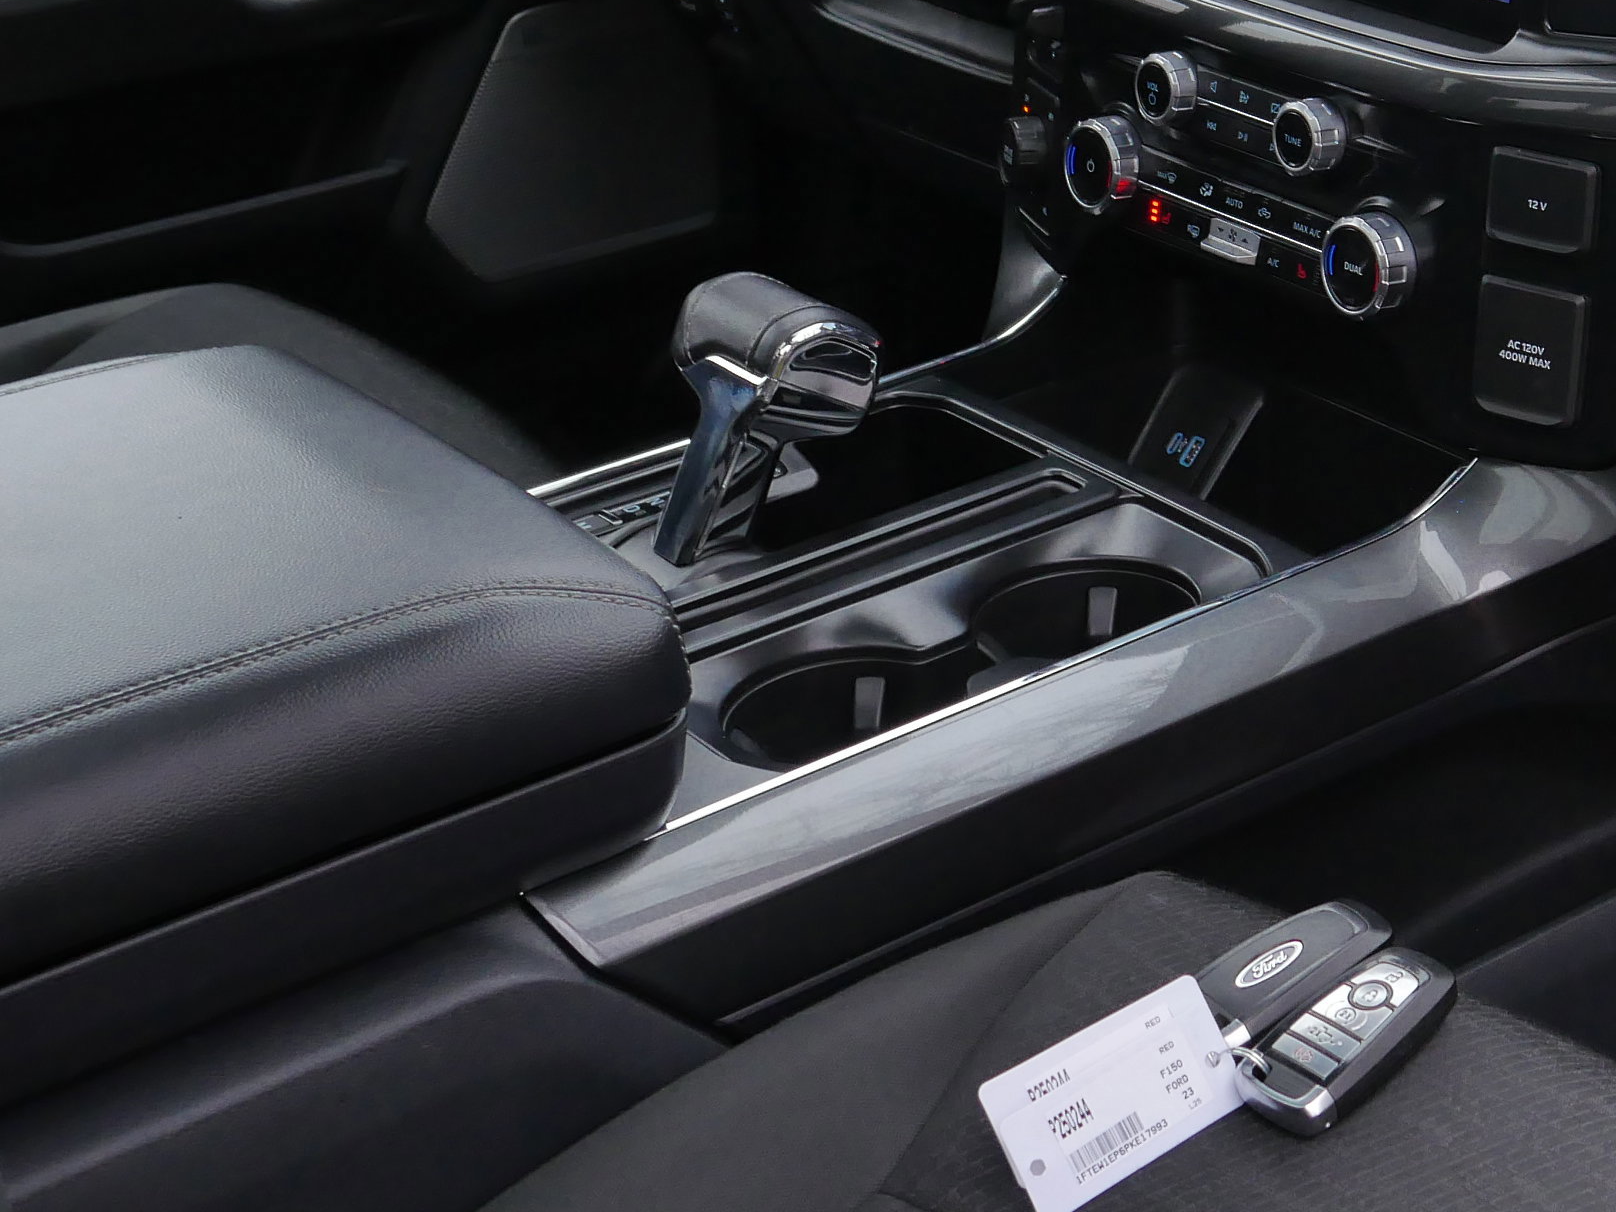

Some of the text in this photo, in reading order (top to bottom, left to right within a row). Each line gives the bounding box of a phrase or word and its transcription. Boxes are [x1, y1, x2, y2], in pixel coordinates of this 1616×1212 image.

[1284, 133, 1303, 148] TUNE
[1225, 196, 1244, 209] AUTO
[1527, 198, 1548, 212] 12 V
[1293, 220, 1322, 239] MAX A/C
[1266, 256, 1280, 269] A/C
[1343, 260, 1364, 277] DUAL
[1507, 339, 1545, 356] AC 120V
[1498, 349, 1551, 370] 400W MAX
[1251, 950, 1288, 980] Ford
[1144, 1015, 1161, 1029] RED
[1158, 1041, 1175, 1055] RED
[1159, 1059, 1184, 1080] F150
[1165, 1074, 1189, 1094] FORD
[1182, 1086, 1195, 1100] 23
